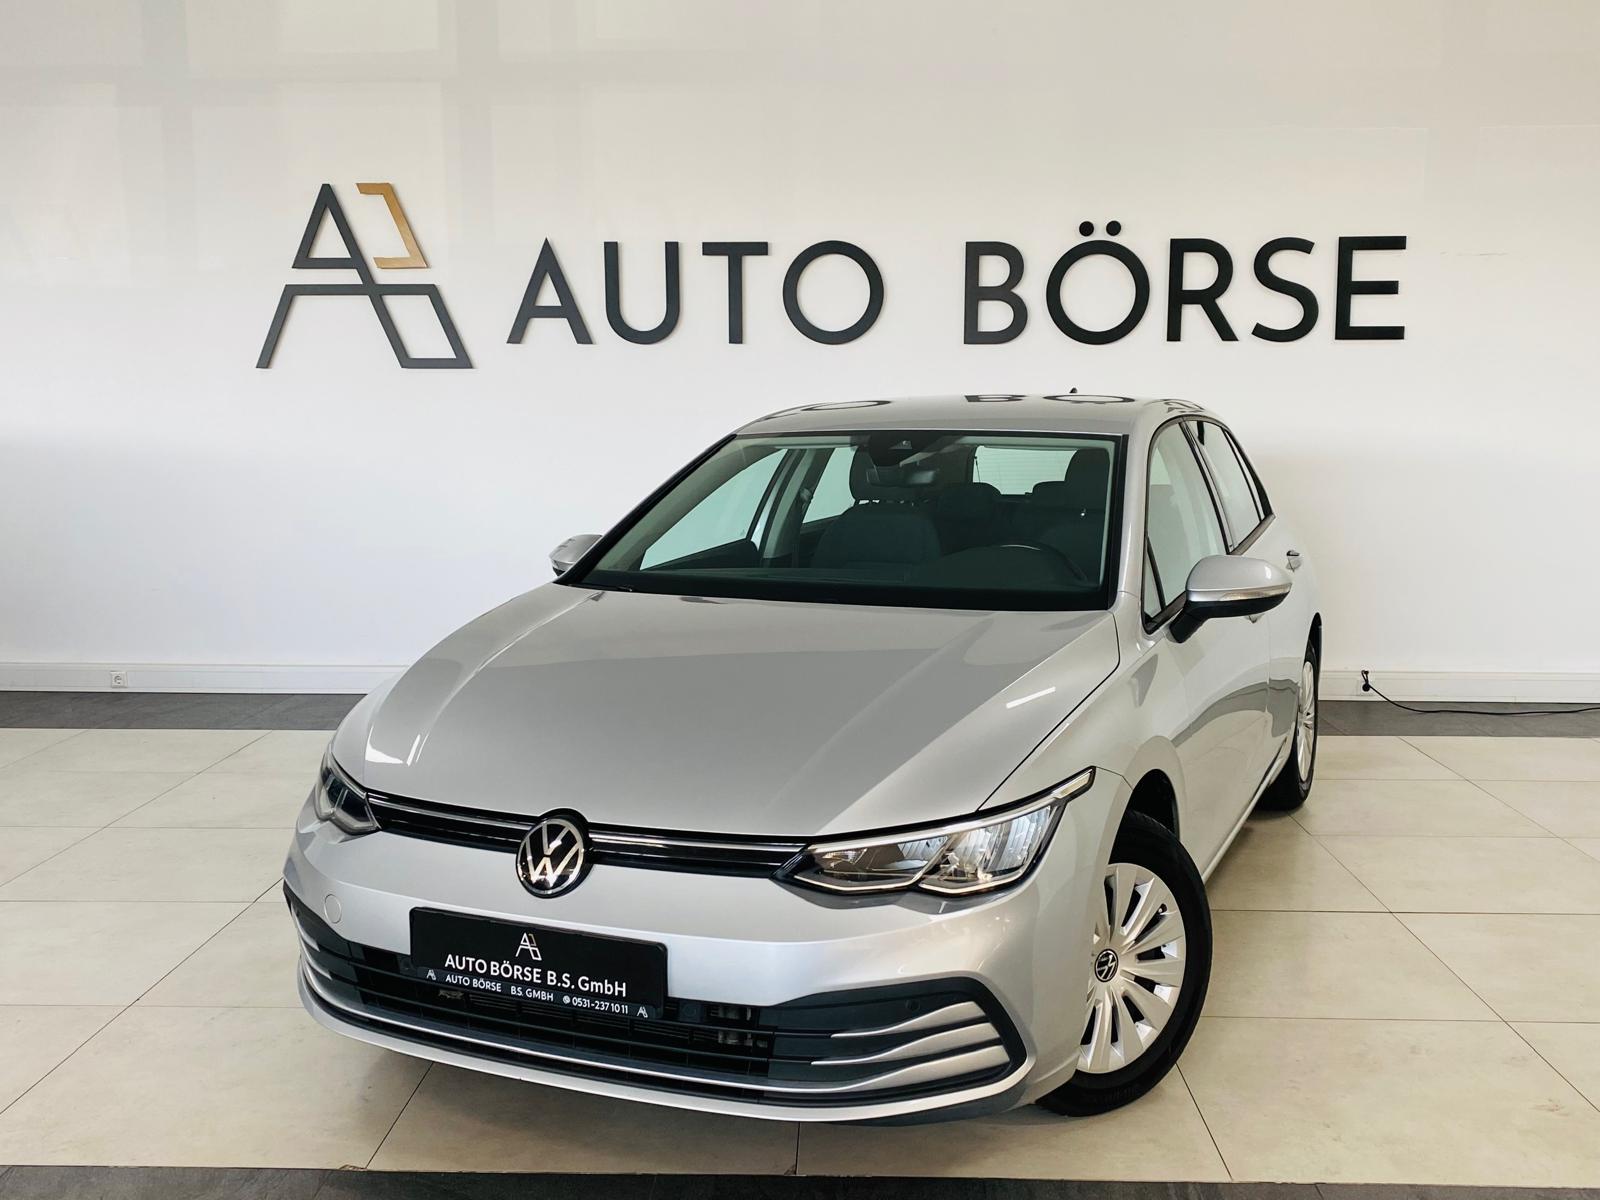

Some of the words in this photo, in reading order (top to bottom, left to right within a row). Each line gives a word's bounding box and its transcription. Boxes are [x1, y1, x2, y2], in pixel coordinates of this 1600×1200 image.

[507, 237, 884, 346] AUTO
[963, 220, 1407, 345] BÖRSE
[444, 953, 488, 974] AUTO
[490, 960, 542, 984] BÖRSE
[546, 970, 575, 990] B.S.
[577, 975, 627, 998] GmbH
[445, 974, 470, 987] AUTO
[472, 978, 502, 992] BÖRSE
[525, 988, 554, 1002] GMBH
